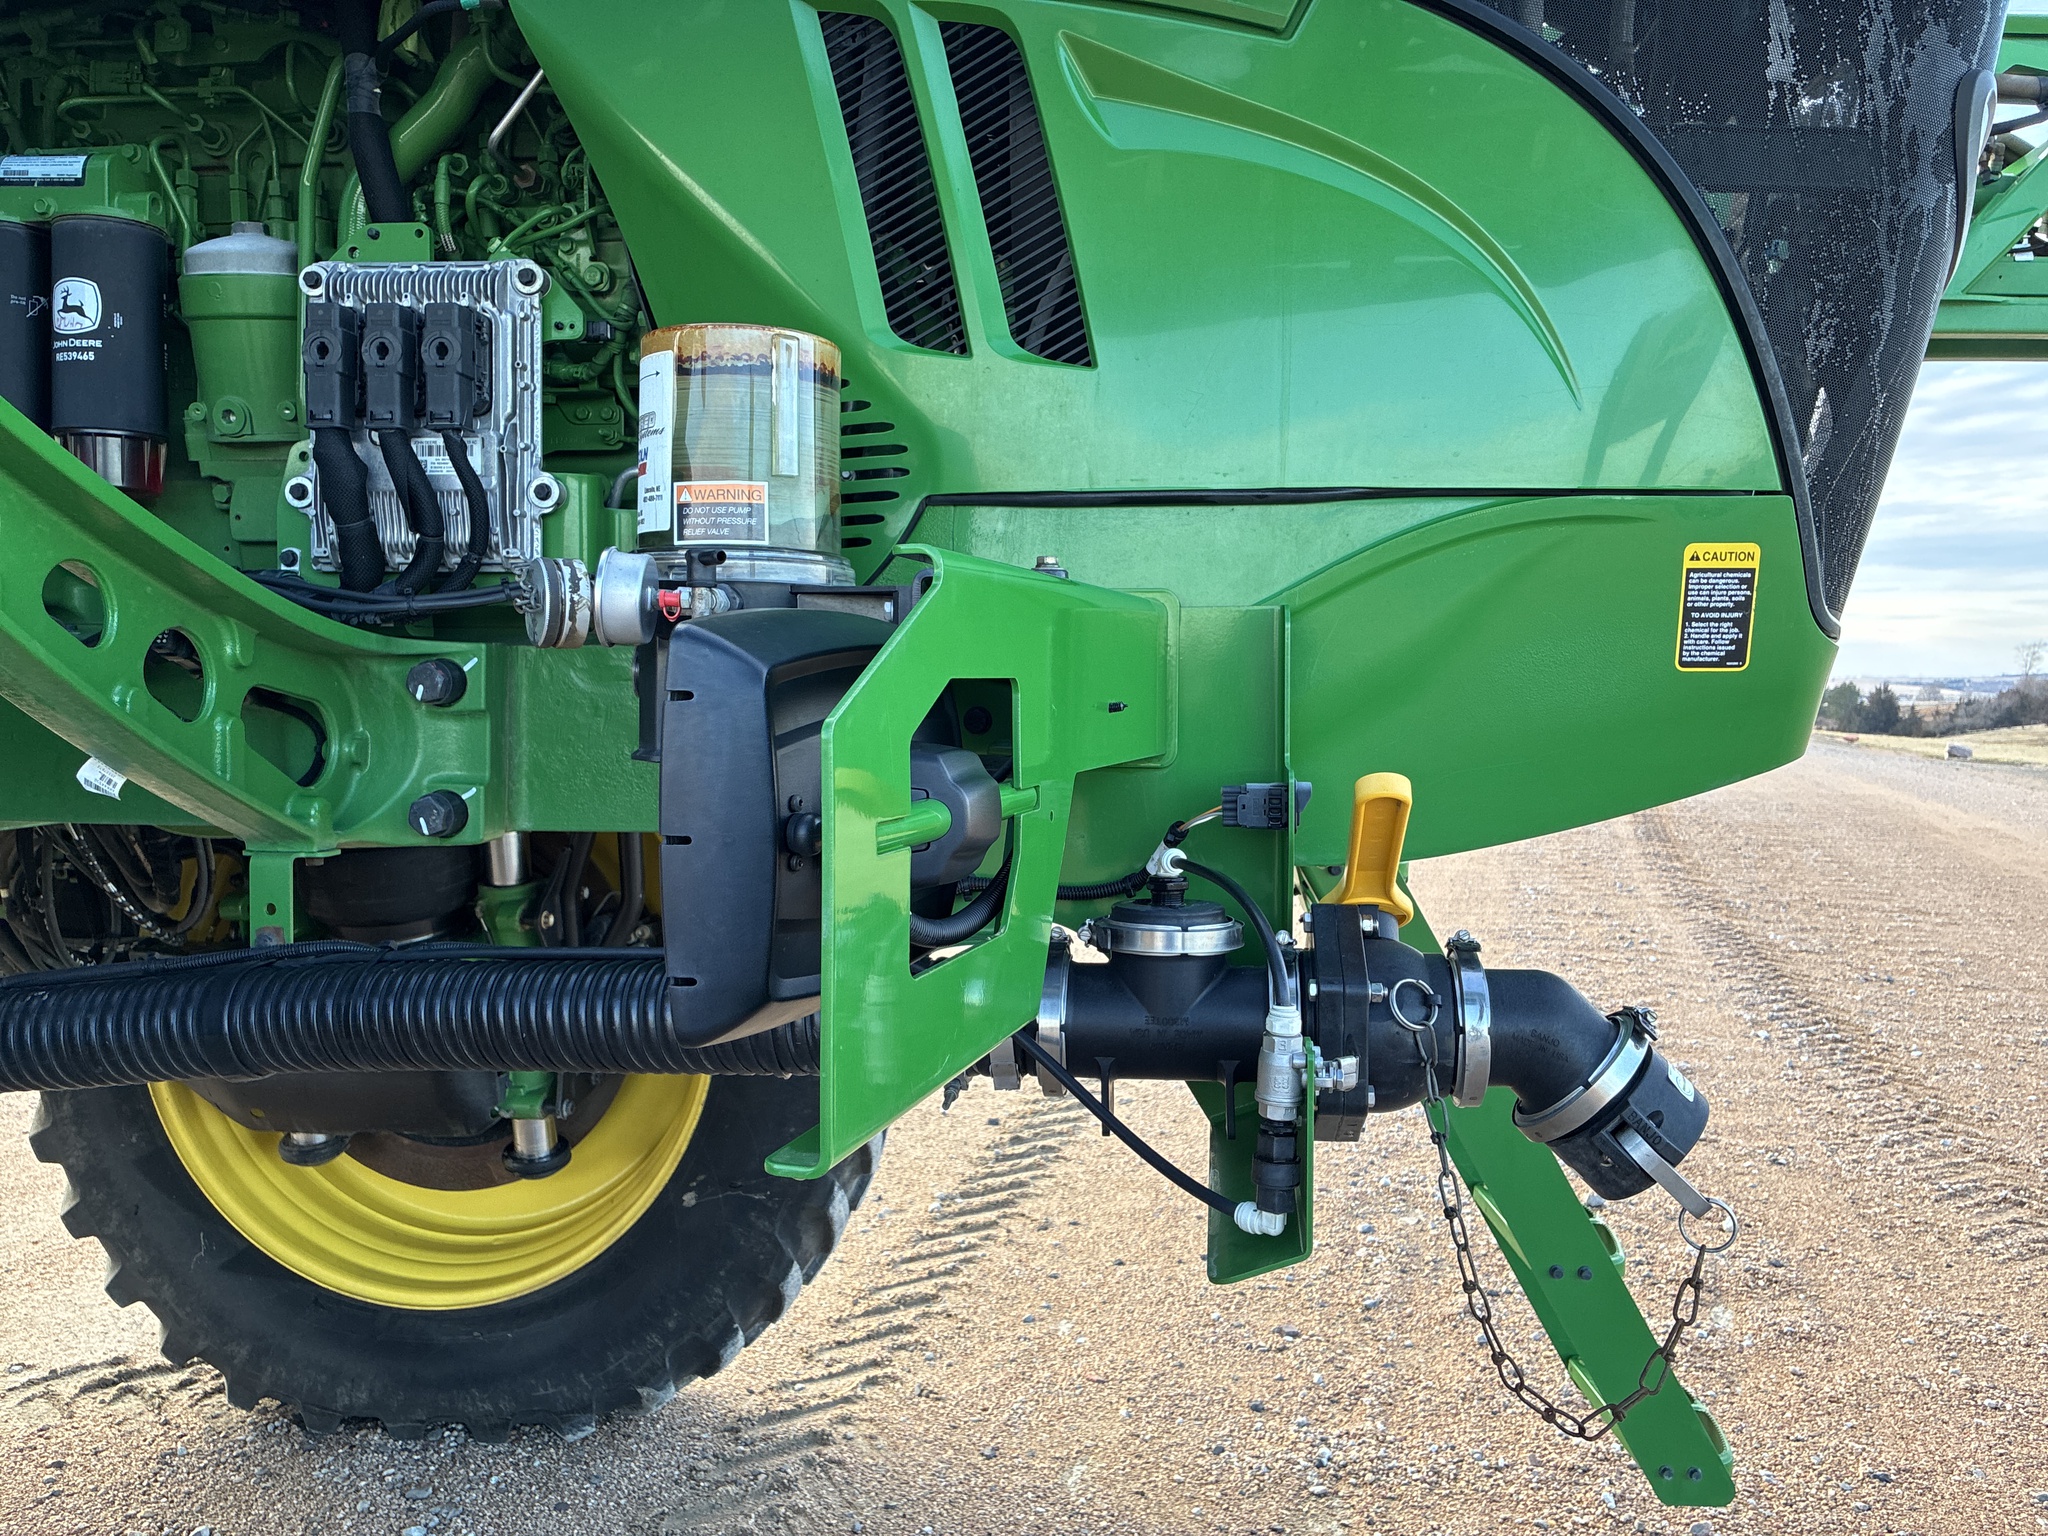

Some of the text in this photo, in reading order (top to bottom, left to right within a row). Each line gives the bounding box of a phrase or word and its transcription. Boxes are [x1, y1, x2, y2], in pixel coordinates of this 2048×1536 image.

[52, 338, 102, 349] JOHN DEERE
[56, 352, 95, 361] RE539465
[694, 489, 762, 500] WARNING
[1702, 552, 1755, 561] CAUTION
[1512, 1032, 1535, 1048] MADE
[1538, 1044, 1547, 1053] IN
[1530, 1028, 1560, 1048] BANJO
[1628, 1110, 1662, 1145] BANJO
